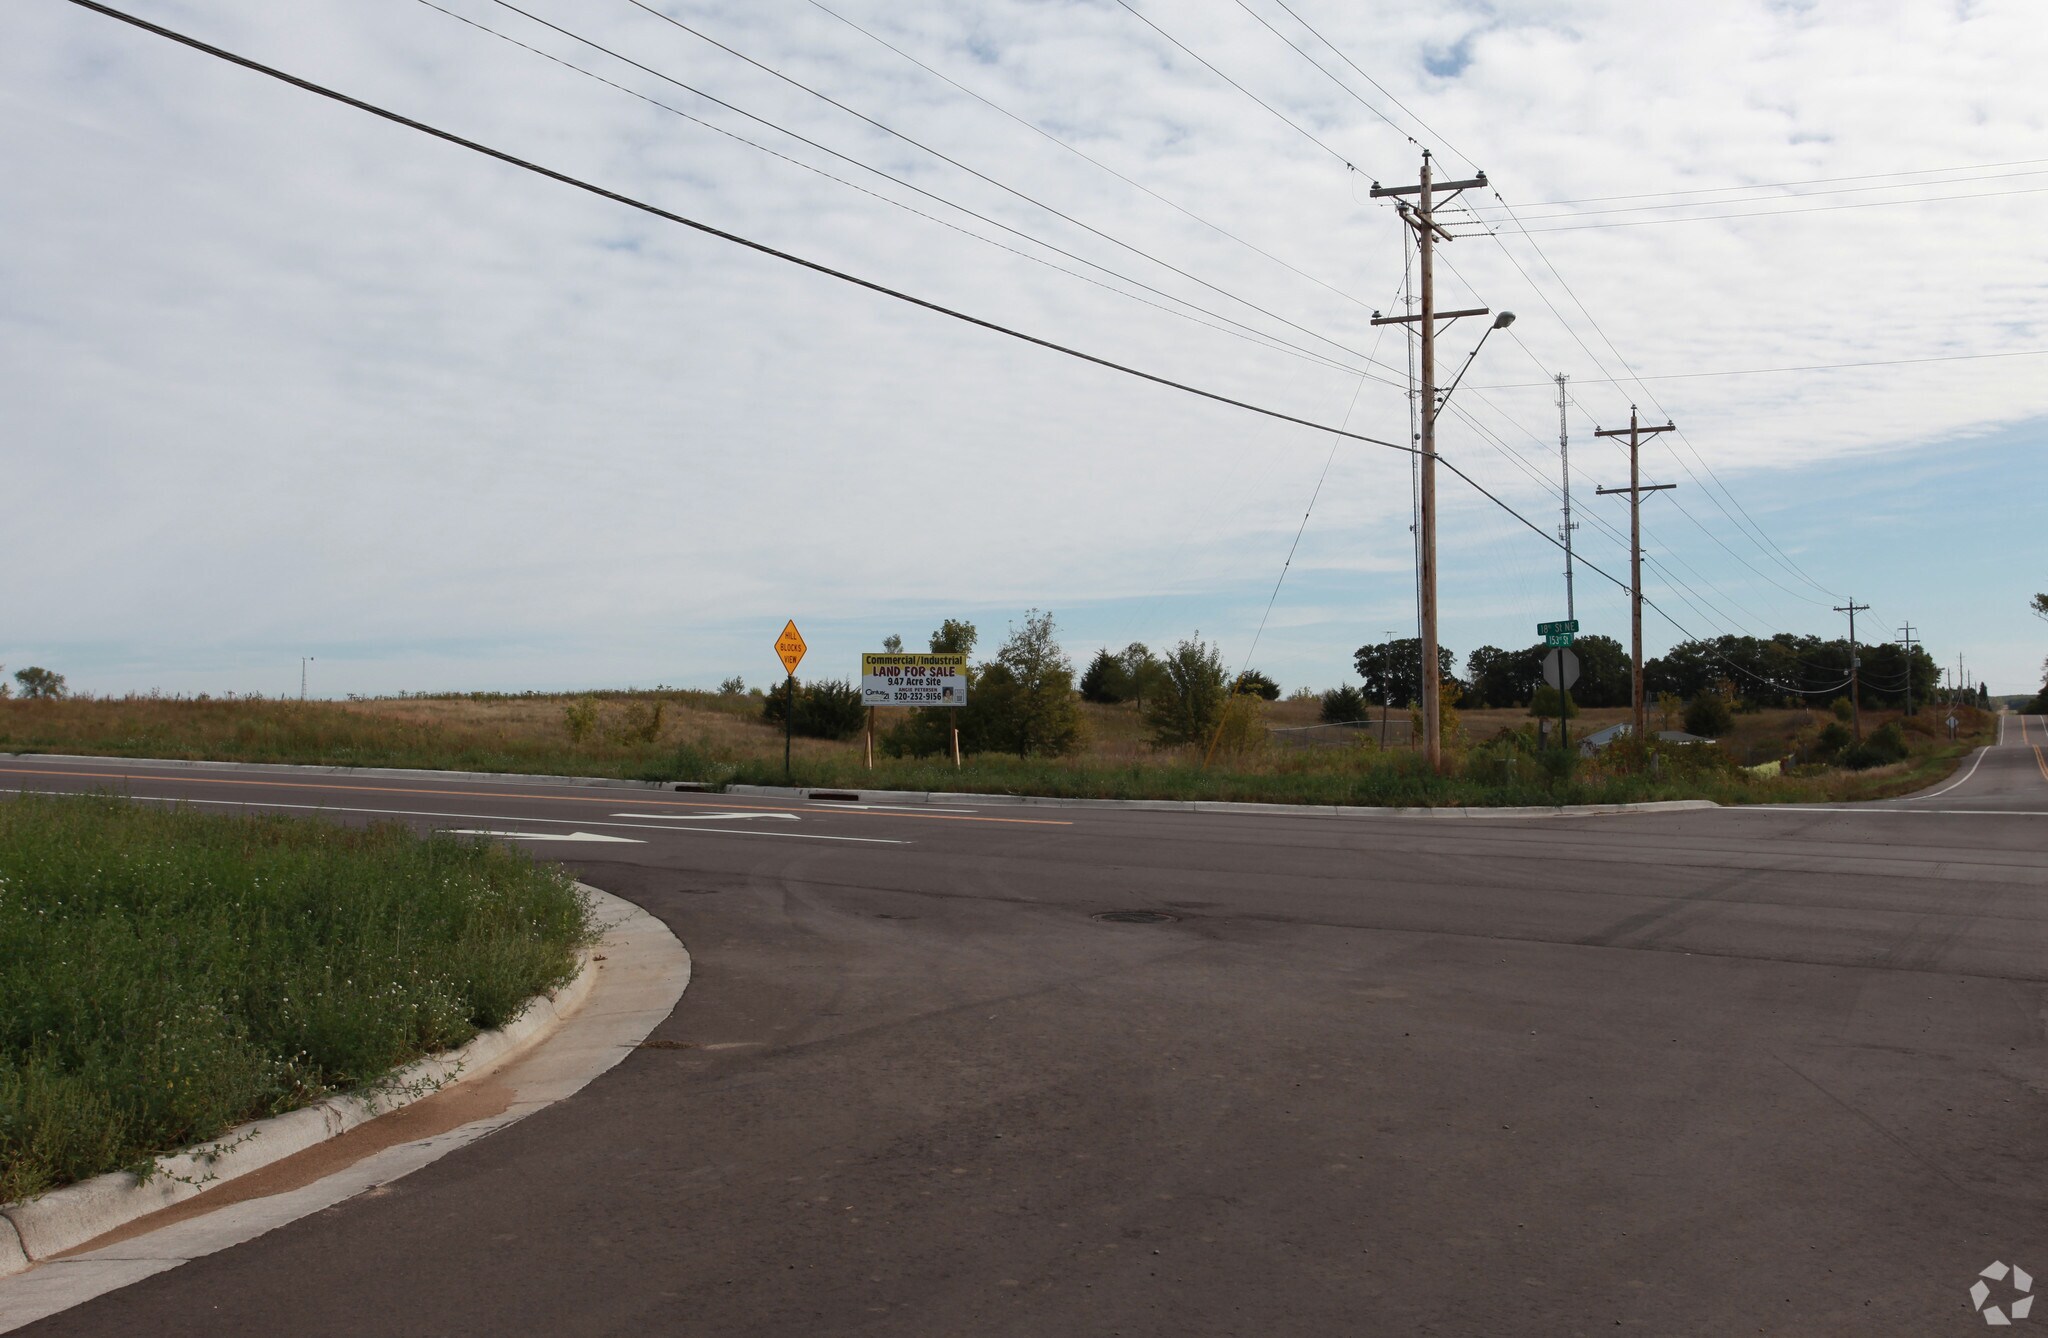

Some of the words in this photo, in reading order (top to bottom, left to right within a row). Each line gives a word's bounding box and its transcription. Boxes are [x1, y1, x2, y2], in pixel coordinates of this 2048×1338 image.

[1555, 623, 1562, 632] St
[1565, 621, 1575, 631] NE
[1563, 635, 1569, 645] St
[780, 643, 801, 652] BLOCKS
[866, 655, 962, 665] Commercial/Industrial
[873, 666, 901, 677] LAND
[904, 666, 926, 677] FOR
[930, 666, 955, 677] SALE
[888, 678, 904, 686] 9.47
[906, 678, 923, 686] Acre
[926, 678, 941, 686] Site
[894, 692, 941, 700] 320-232-9156
